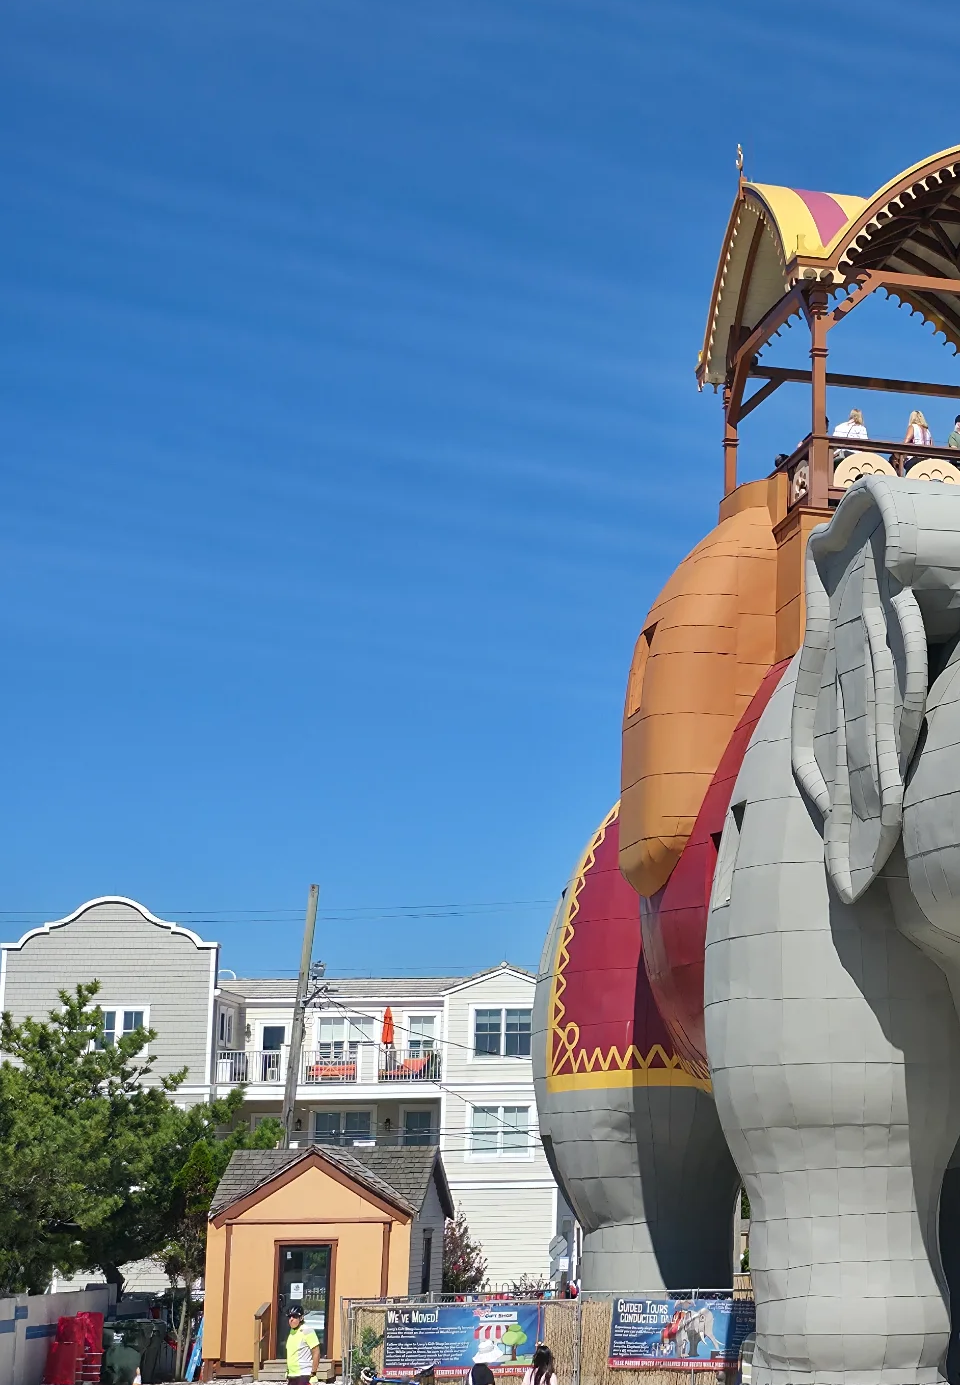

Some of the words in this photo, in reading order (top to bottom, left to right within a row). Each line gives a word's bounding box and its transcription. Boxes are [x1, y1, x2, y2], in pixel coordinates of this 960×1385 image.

[617, 1299, 643, 1313] GUIDED
[645, 1300, 669, 1314] TOURS
[411, 1309, 439, 1323] MOVED!
[620, 1313, 658, 1324] CONDUCTED
